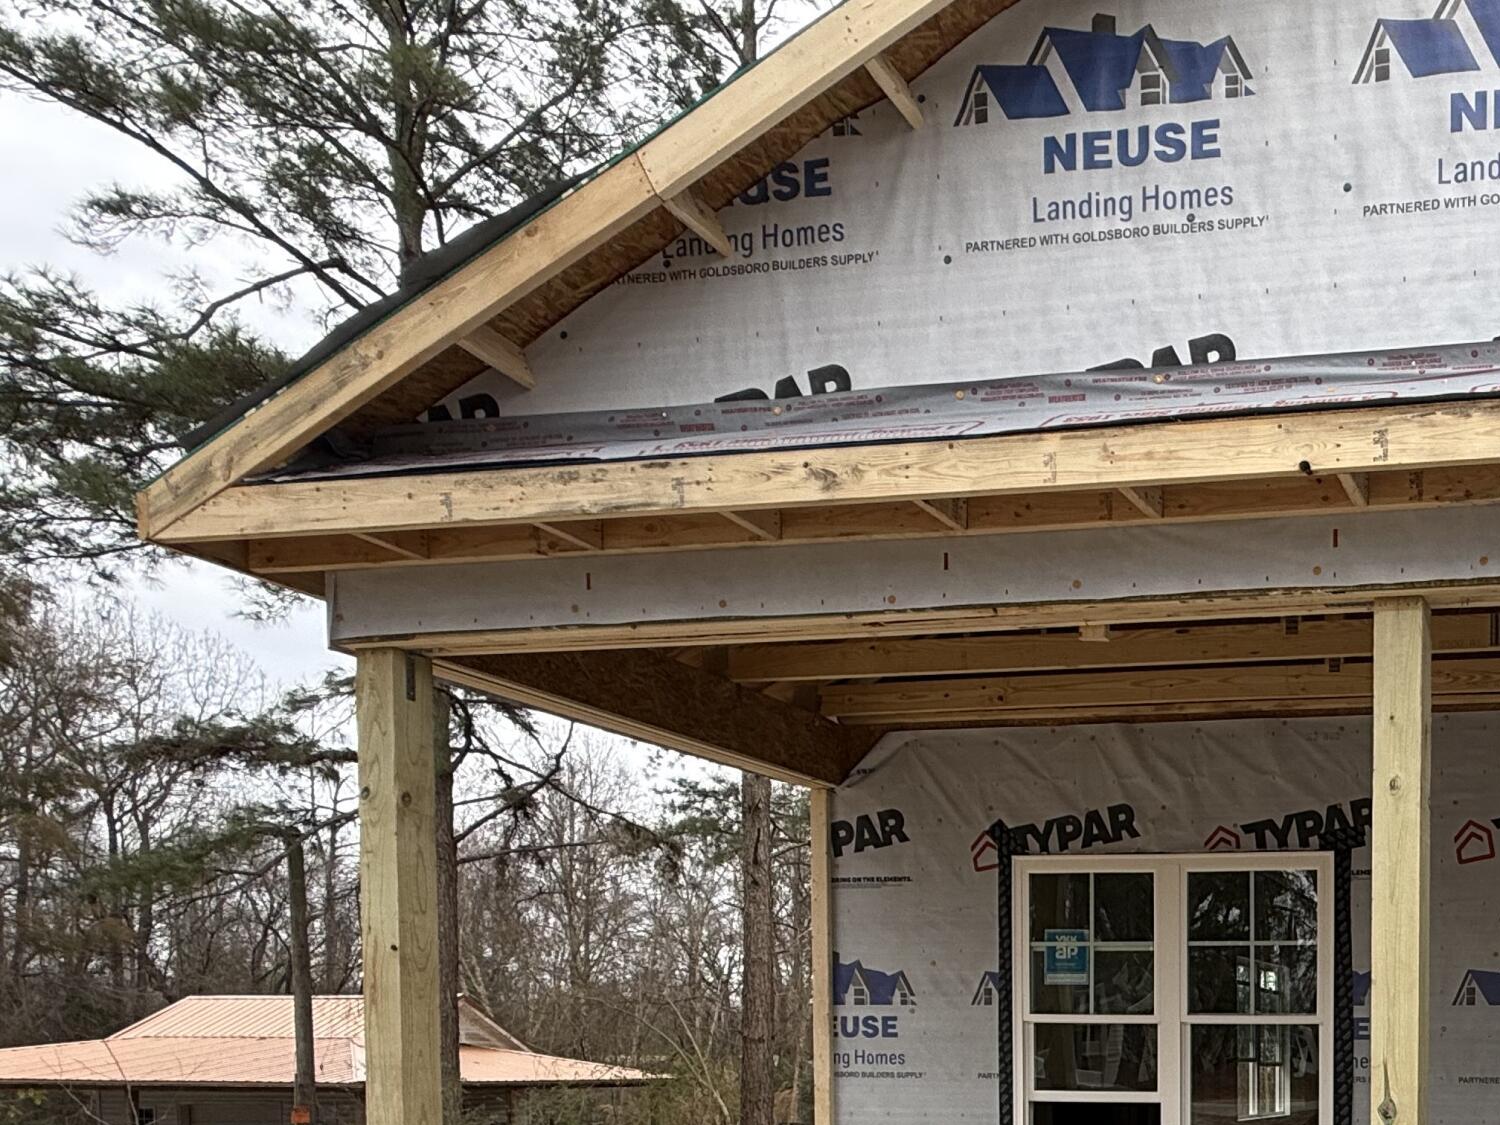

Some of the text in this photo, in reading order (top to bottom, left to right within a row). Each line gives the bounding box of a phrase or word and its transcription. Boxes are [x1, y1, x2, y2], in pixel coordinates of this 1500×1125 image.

[1042, 118, 1222, 174] NEUSE
[727, 157, 832, 207] USE
[1032, 184, 1234, 223] Landing Homes
[1362, 199, 1441, 218] PARTNERED
[1444, 195, 1477, 210] WITH
[762, 222, 845, 250] Homes
[965, 236, 1036, 253] PARTNERED
[1039, 232, 1069, 247] WITH
[1072, 225, 1149, 244] GOLDSBORO
[1152, 219, 1213, 236] BUILDERS
[669, 270, 697, 281] WITH
[699, 261, 770, 279] GOLDSBORO
[772, 257, 828, 272] BUILDERS
[831, 809, 910, 857] PAR
[834, 1015, 898, 1038] USE
[854, 1049, 906, 1065] Homes
